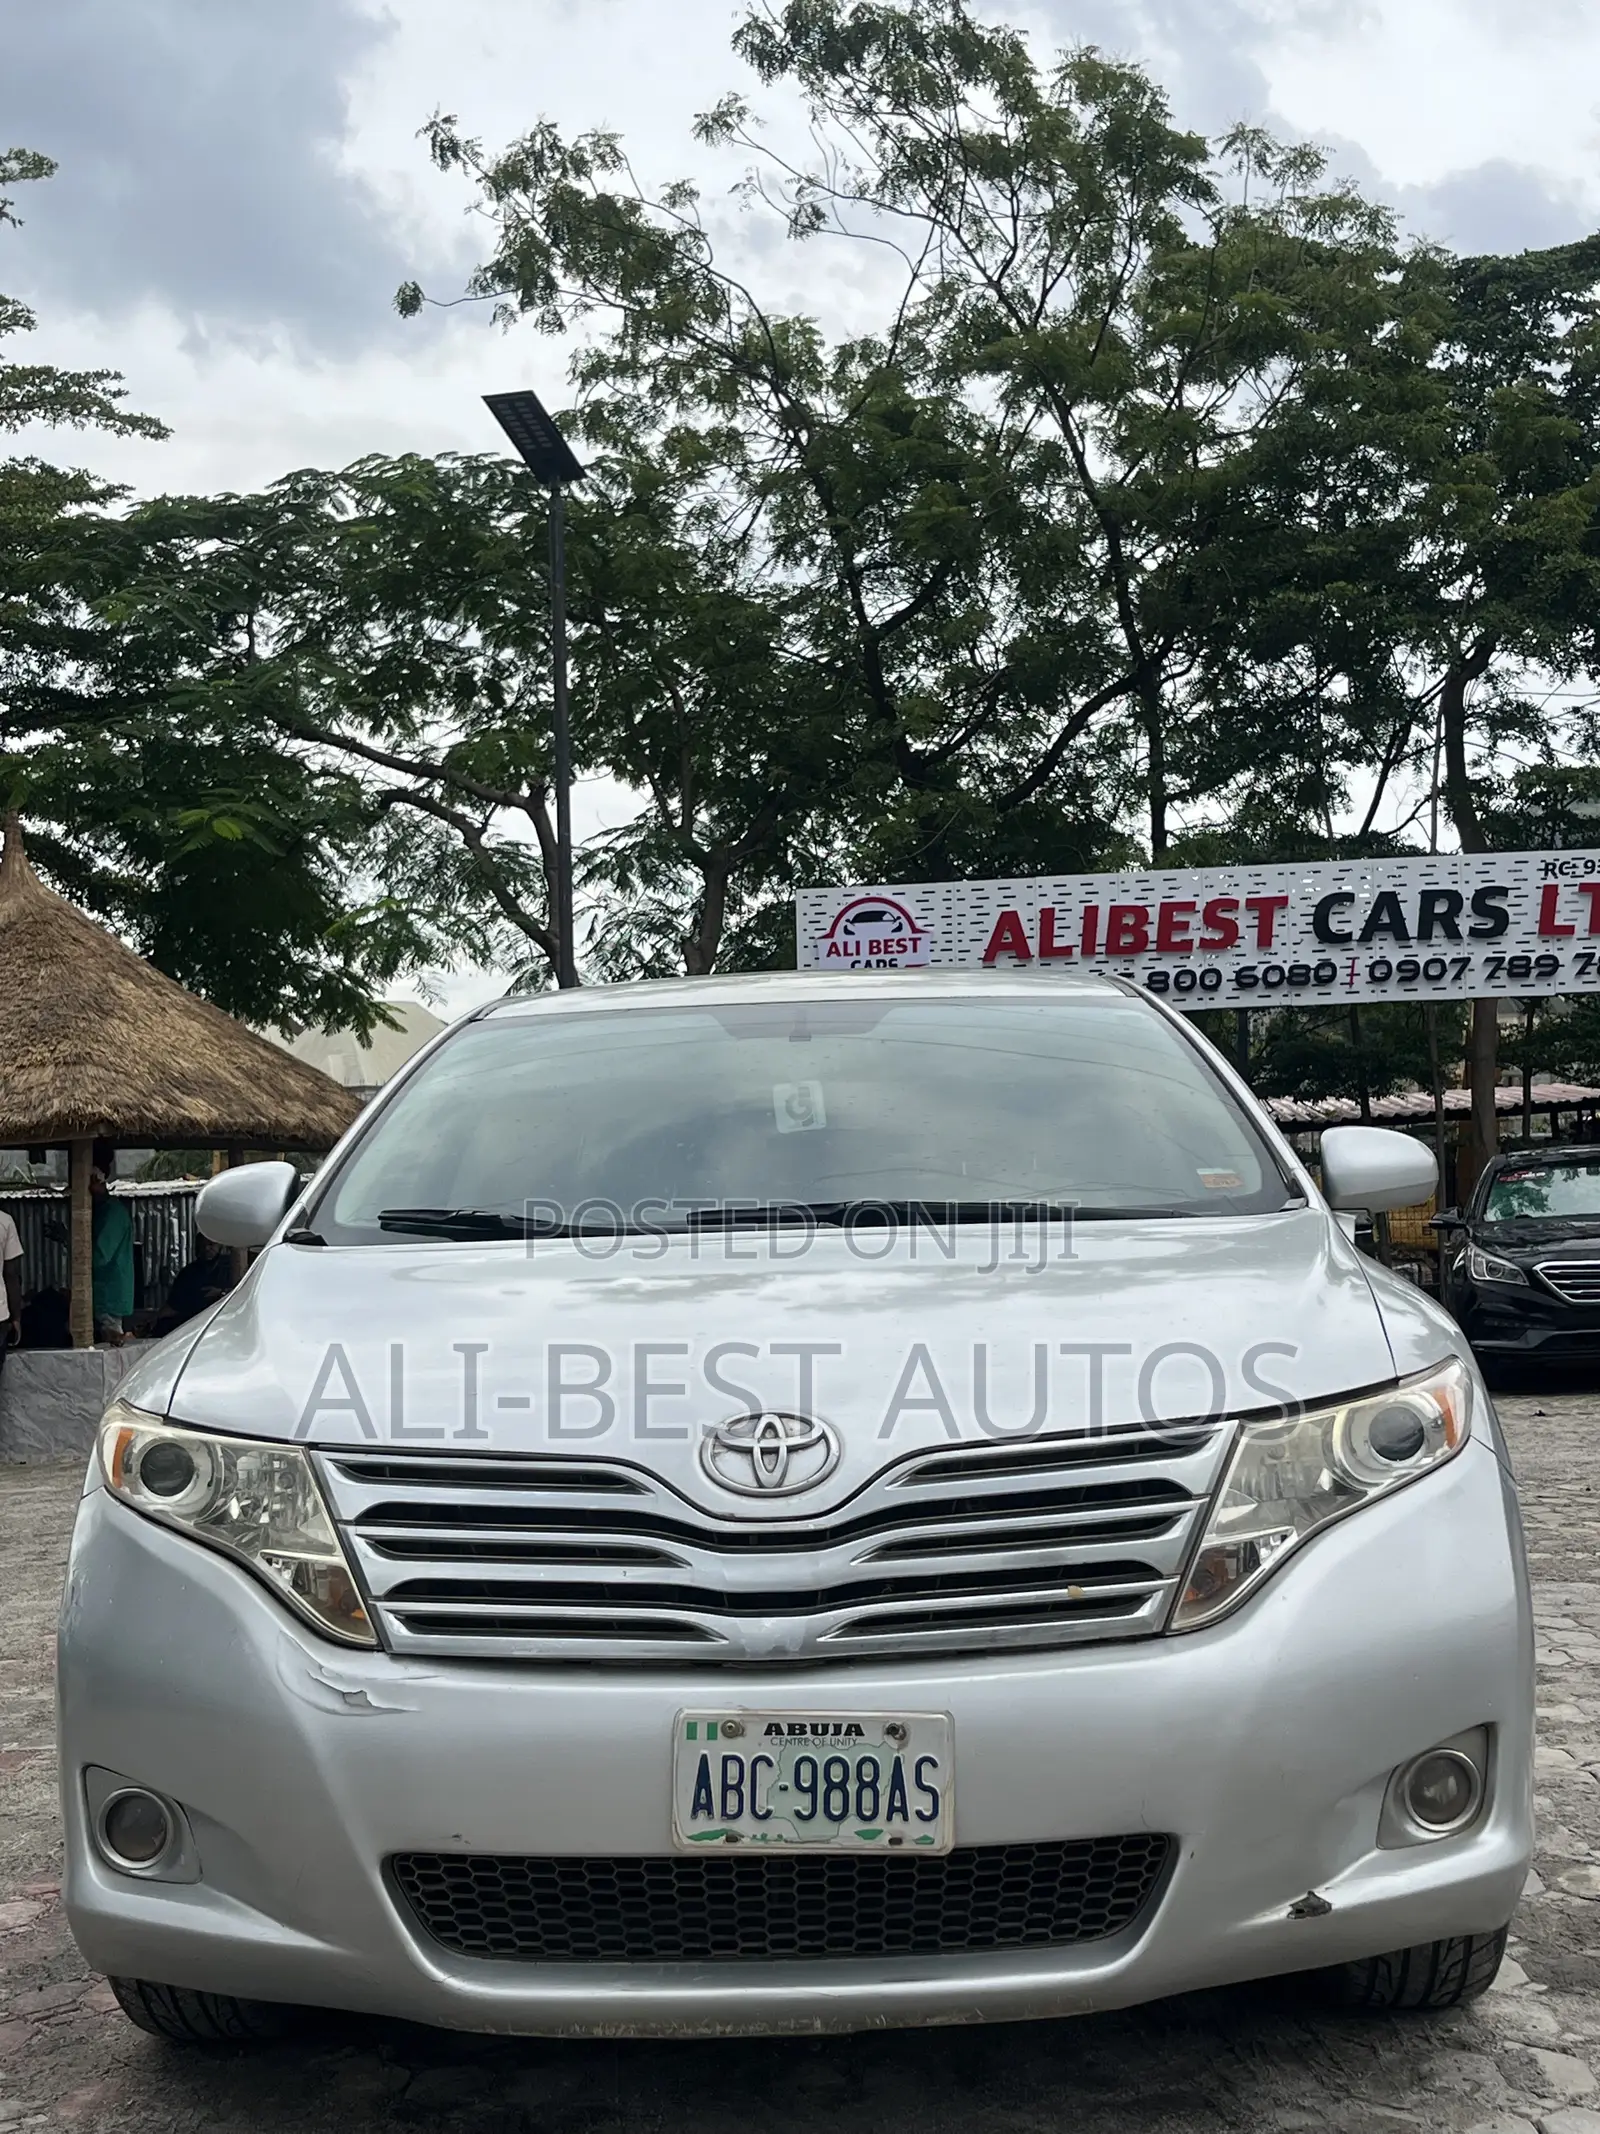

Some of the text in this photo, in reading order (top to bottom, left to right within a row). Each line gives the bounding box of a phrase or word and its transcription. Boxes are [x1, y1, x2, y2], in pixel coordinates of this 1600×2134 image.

[1583, 859, 1600, 875] 9
[983, 896, 1289, 962] ALIBEST
[1312, 886, 1510, 944] CARS
[826, 937, 922, 957] ALI BEST
[1147, 967, 1223, 992] 800
[1235, 960, 1338, 990] 6080
[1369, 955, 1471, 983] 0907
[1484, 953, 1560, 981] 789
[1573, 952, 1600, 976] 7
[763, 1722, 865, 1737] ABUJA
[770, 1736, 858, 1747] CENTRE OF UNITY
[690, 1753, 940, 1823] ABC-988AS
